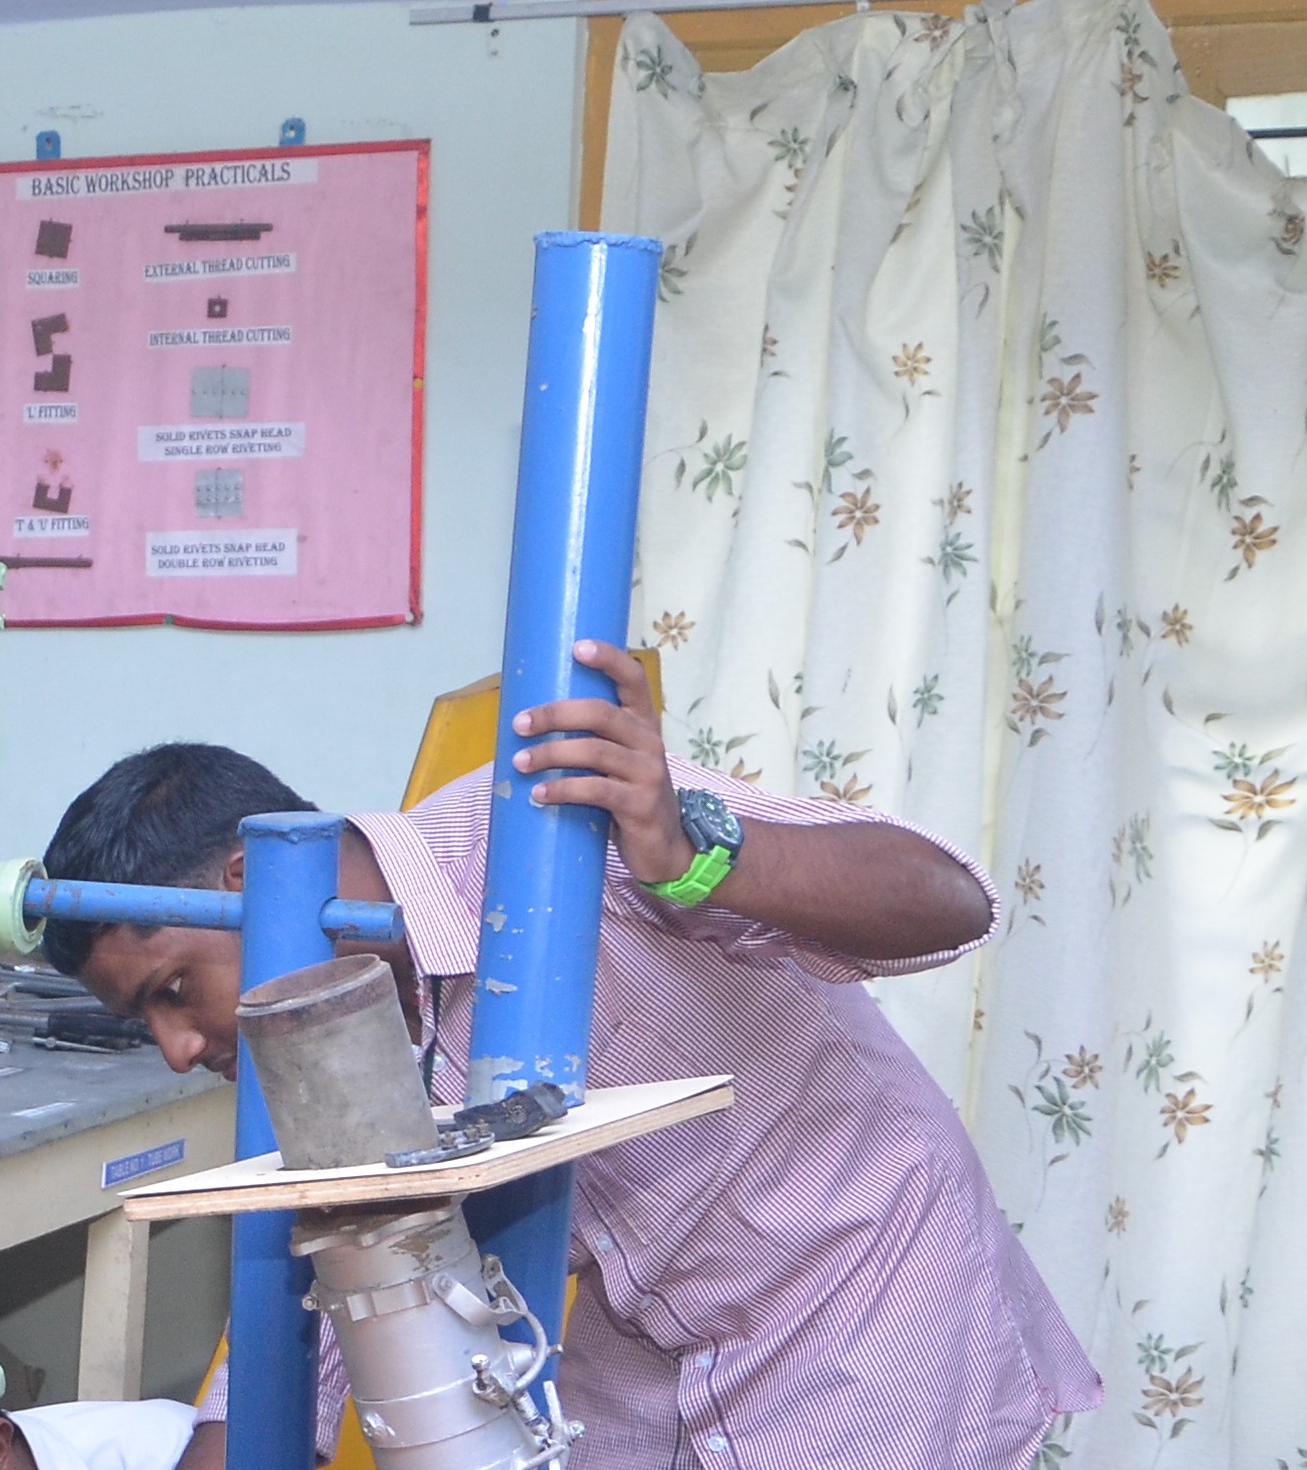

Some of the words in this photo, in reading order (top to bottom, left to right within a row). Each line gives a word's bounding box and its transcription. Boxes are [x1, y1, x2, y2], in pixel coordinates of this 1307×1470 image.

[31, 175, 81, 197] BASIC
[84, 169, 175, 193] WORKSHOP
[185, 162, 291, 187] PRACTICALS
[144, 261, 200, 278] EXTERNAL
[201, 257, 243, 275] THREAD
[244, 254, 291, 271] CUTTING
[27, 271, 78, 284] SQUARING
[149, 332, 199, 346] INTERNAL
[202, 329, 244, 344] THREAD
[245, 327, 291, 342] CUTTING
[38, 405, 77, 418] FITTING
[155, 431, 185, 442] SOLID
[188, 429, 227, 441] RIVETS
[229, 428, 258, 439] SNAP
[260, 427, 292, 438] HEAD
[164, 444, 203, 456] SINGLE
[205, 443, 229, 454] ROW
[232, 442, 282, 454] RIVETING
[51, 516, 89, 530] FITTING
[151, 545, 181, 555] SOLID
[183, 543, 221, 554] RIVETS
[255, 542, 285, 552] HEAD
[158, 558, 199, 569] DOUBLE
[202, 557, 226, 568] ROW
[228, 556, 278, 567] RIVETING
